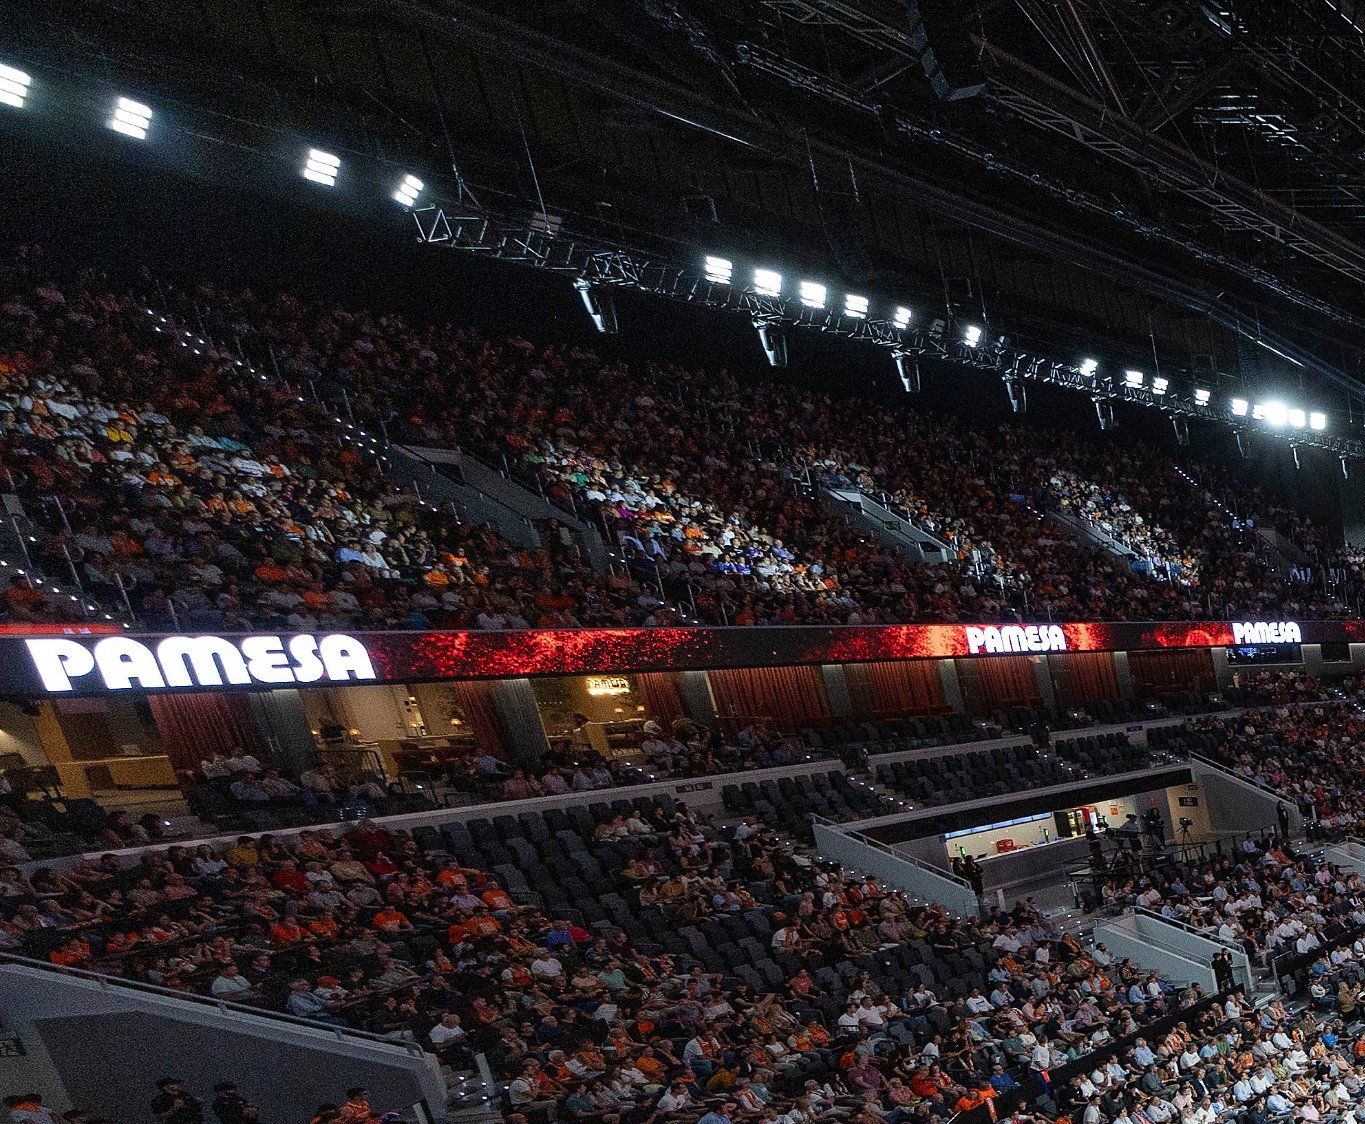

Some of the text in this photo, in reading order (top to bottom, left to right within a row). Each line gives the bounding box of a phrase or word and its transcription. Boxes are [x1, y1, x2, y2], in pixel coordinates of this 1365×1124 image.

[966, 625, 1066, 653] PAMESA
[1233, 622, 1302, 644] PAMESA
[26, 635, 376, 692] PAMESA
